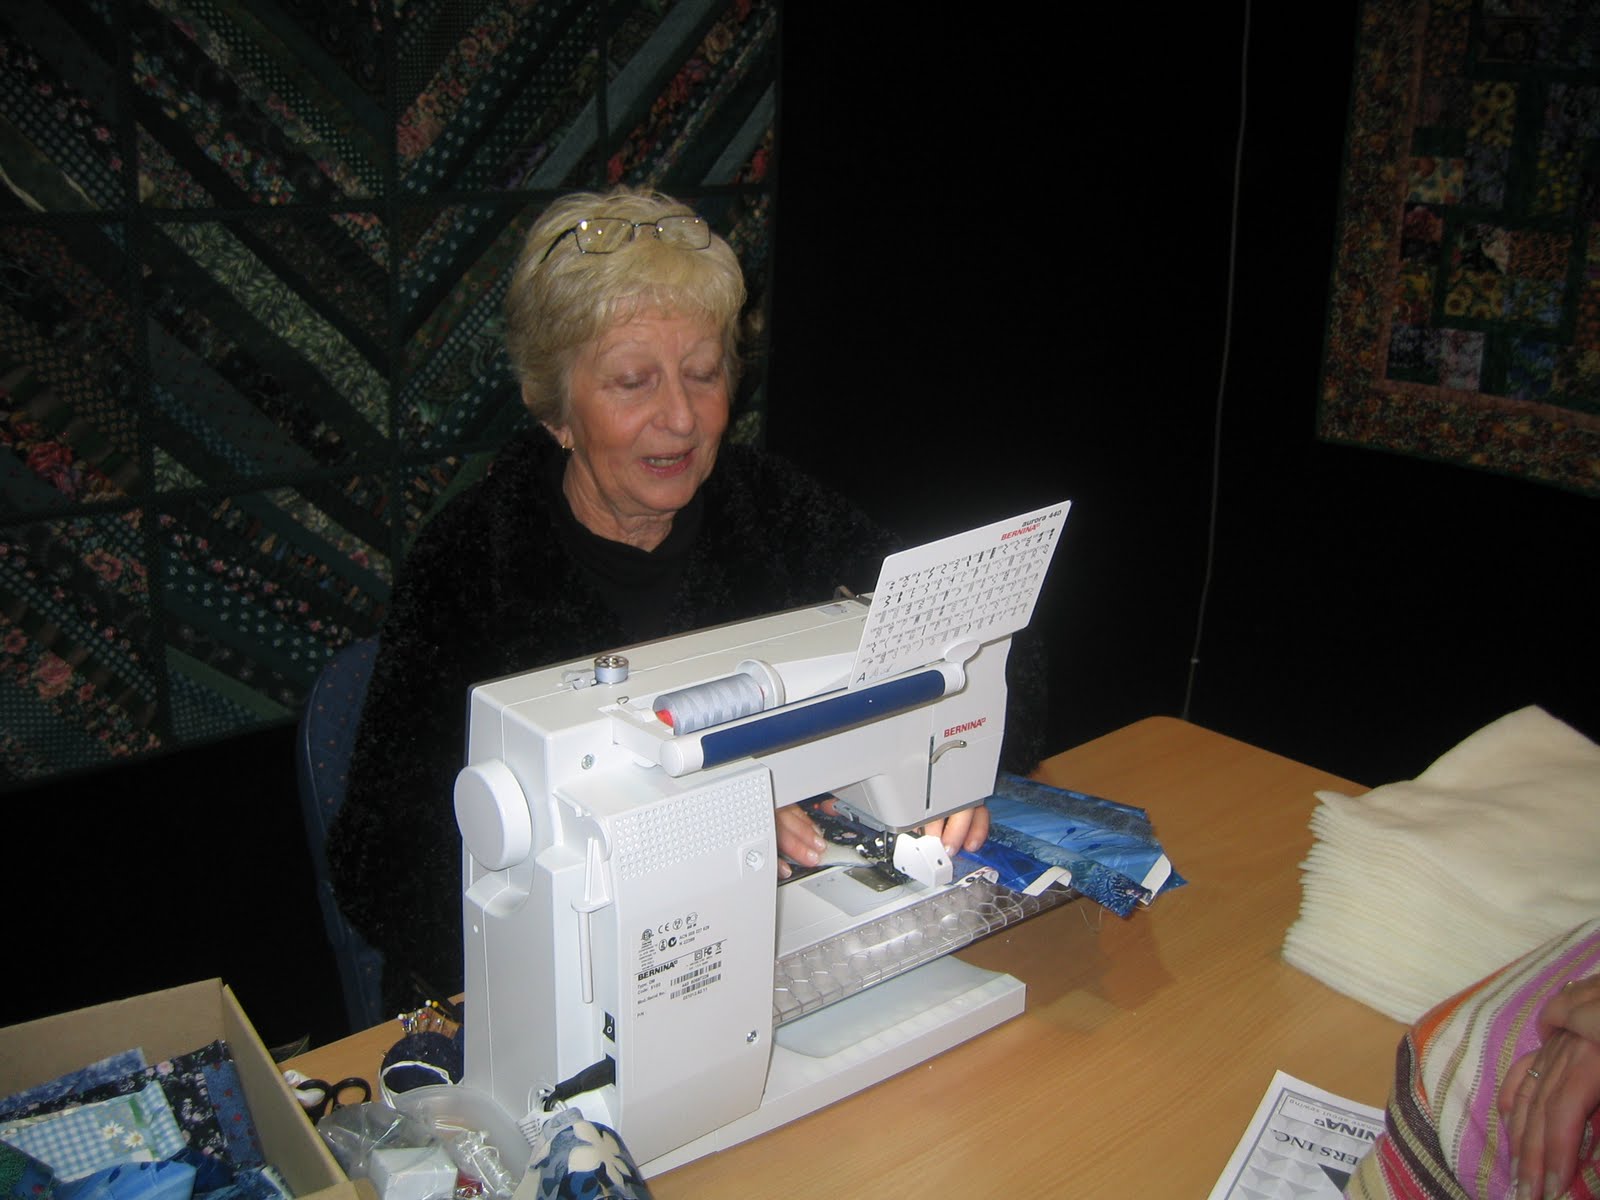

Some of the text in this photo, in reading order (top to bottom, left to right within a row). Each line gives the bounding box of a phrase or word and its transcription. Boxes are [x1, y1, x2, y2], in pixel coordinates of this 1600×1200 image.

[1022, 510, 1062, 527] aurora 440
[1001, 524, 1038, 540] BERNINA
[856, 672, 866, 683] A
[944, 718, 983, 738] BERNINA
[638, 961, 676, 981] BERNINA
[1272, 1129, 1358, 1165] ERS INC.
